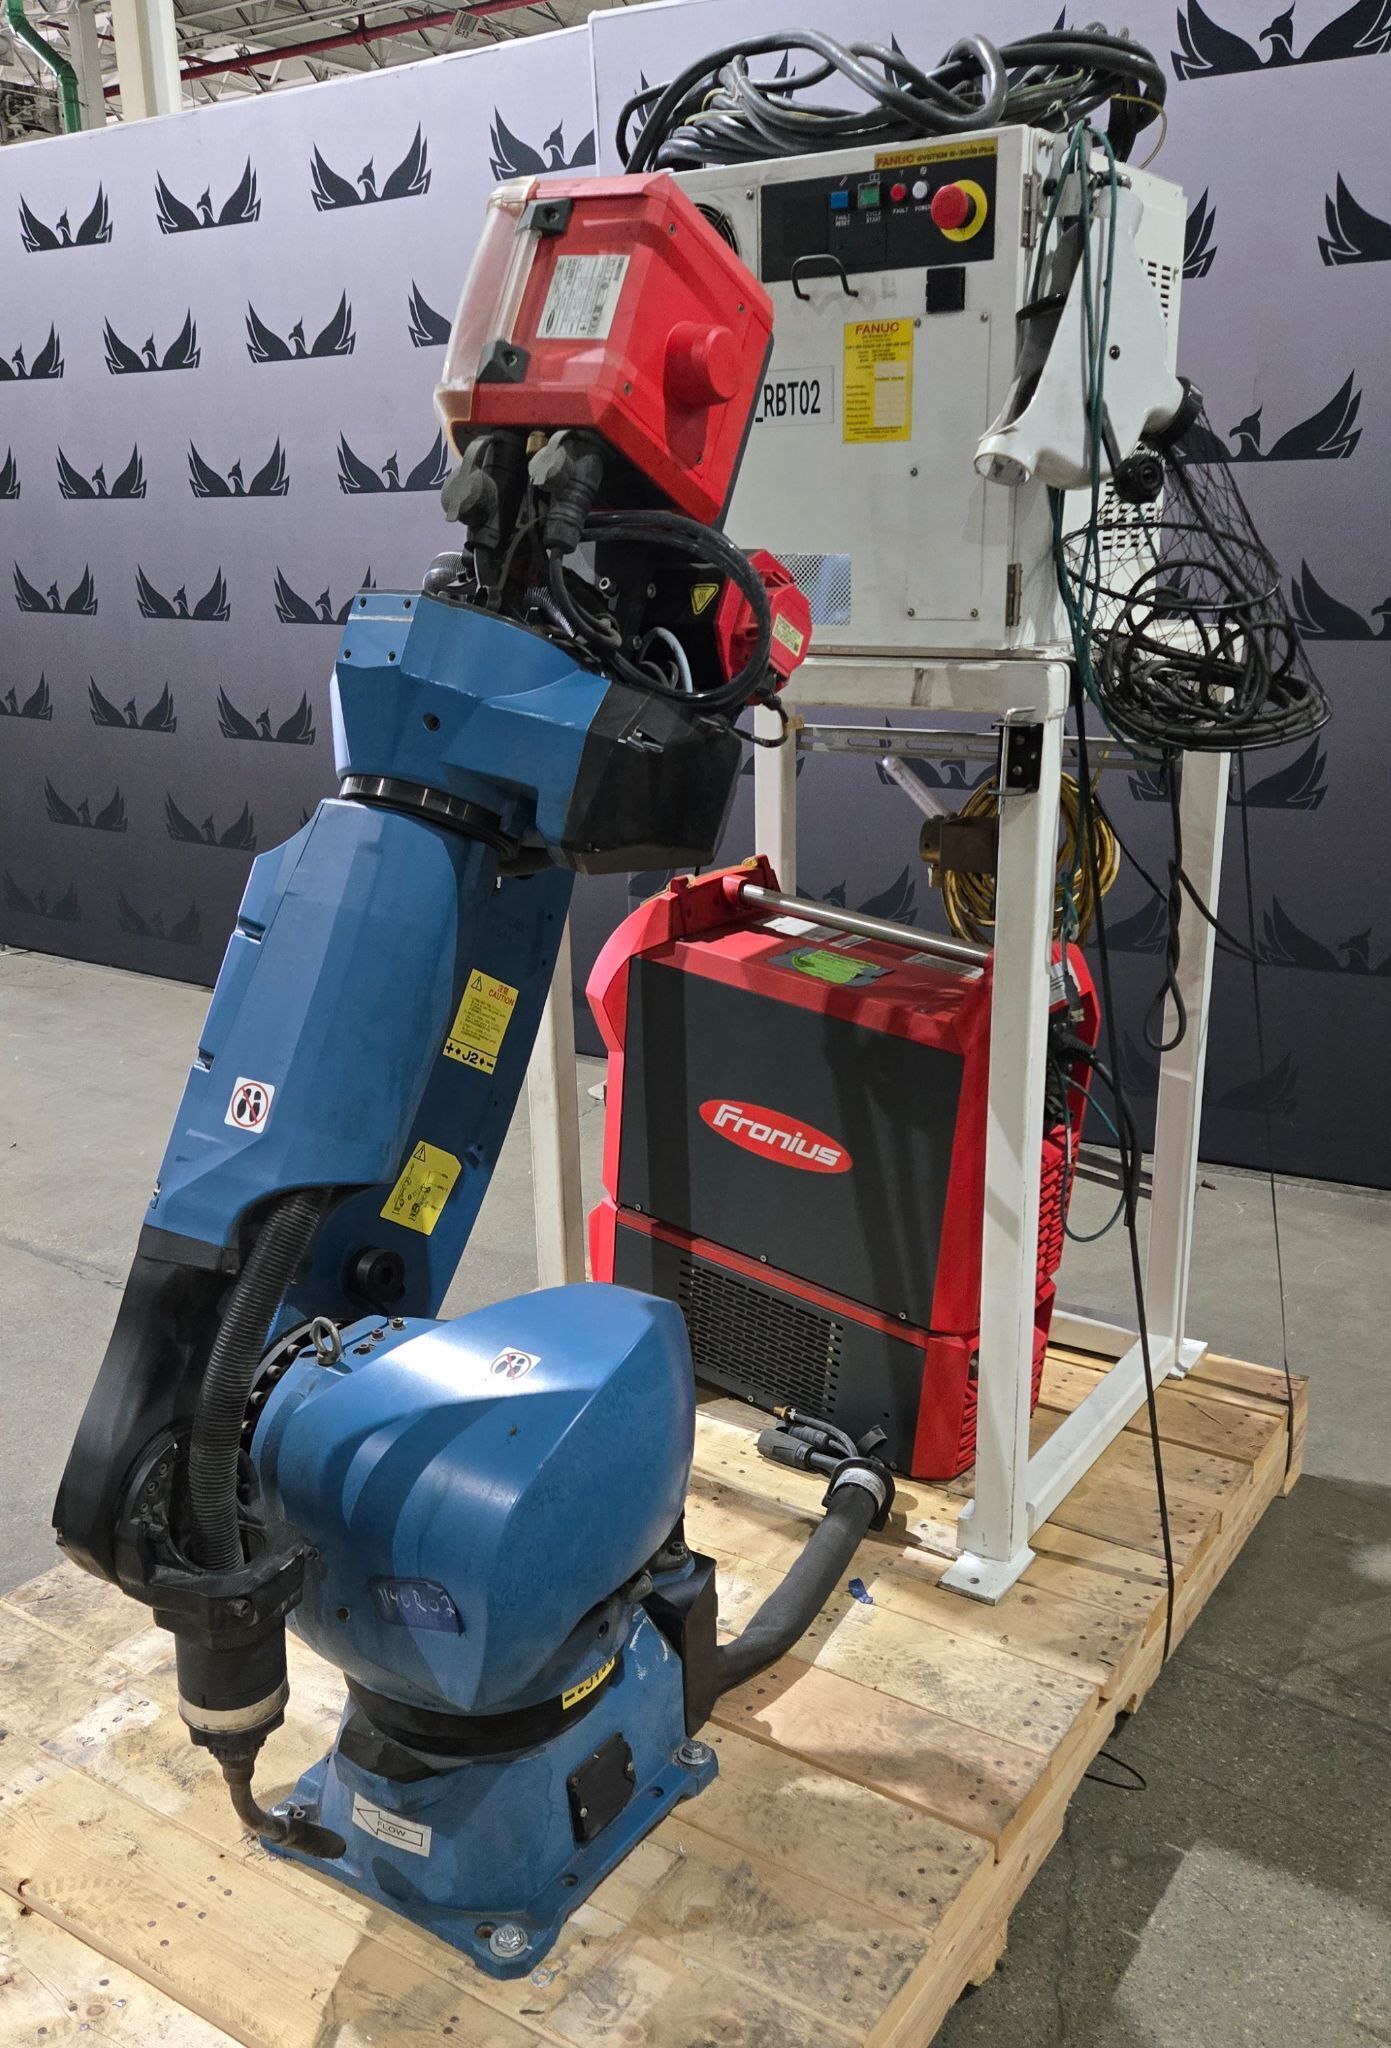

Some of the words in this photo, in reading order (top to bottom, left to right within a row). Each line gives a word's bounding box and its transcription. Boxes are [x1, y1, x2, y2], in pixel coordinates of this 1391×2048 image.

[876, 154, 914, 168] FANUC
[917, 152, 948, 162] SYSTEM
[892, 206, 909, 214] FAULT
[866, 216, 881, 224] START
[855, 321, 900, 335] FANUC
[488, 988, 514, 1006] CAUTION
[462, 1050, 479, 1065] J2
[712, 1103, 842, 1167] Fronius
[377, 1820, 406, 1837] FLOW
